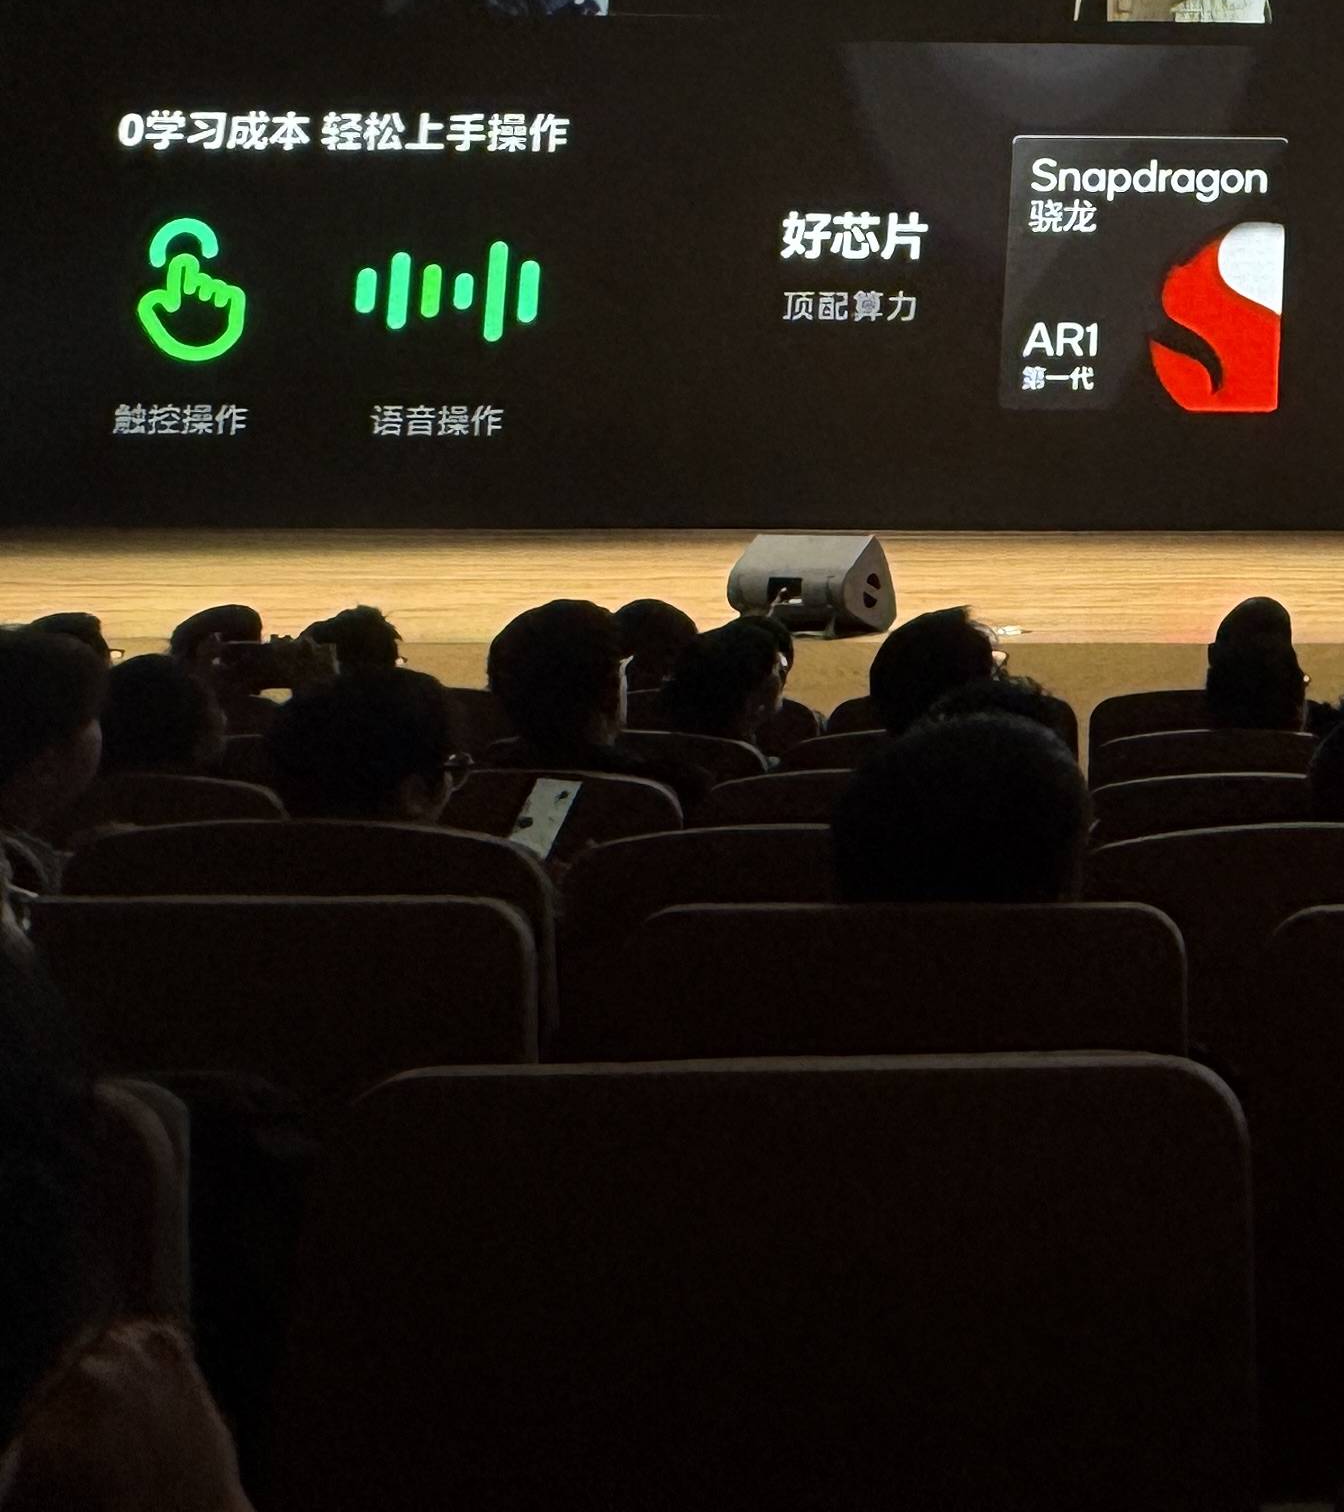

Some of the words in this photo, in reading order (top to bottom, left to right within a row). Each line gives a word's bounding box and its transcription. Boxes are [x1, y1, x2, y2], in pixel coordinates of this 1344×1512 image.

[118, 110, 310, 150] 0学习成本
[321, 112, 570, 152] 轻松上手操作
[1031, 158, 1267, 202] Snapdragon
[1028, 199, 1097, 232] 骁龙
[781, 211, 928, 260] 好芯片
[783, 291, 916, 321] 顶配算力
[1023, 322, 1098, 357] AR1
[1022, 366, 1094, 390] 第一代
[113, 403, 248, 435] 触控操作
[371, 405, 504, 436] 语音操作
